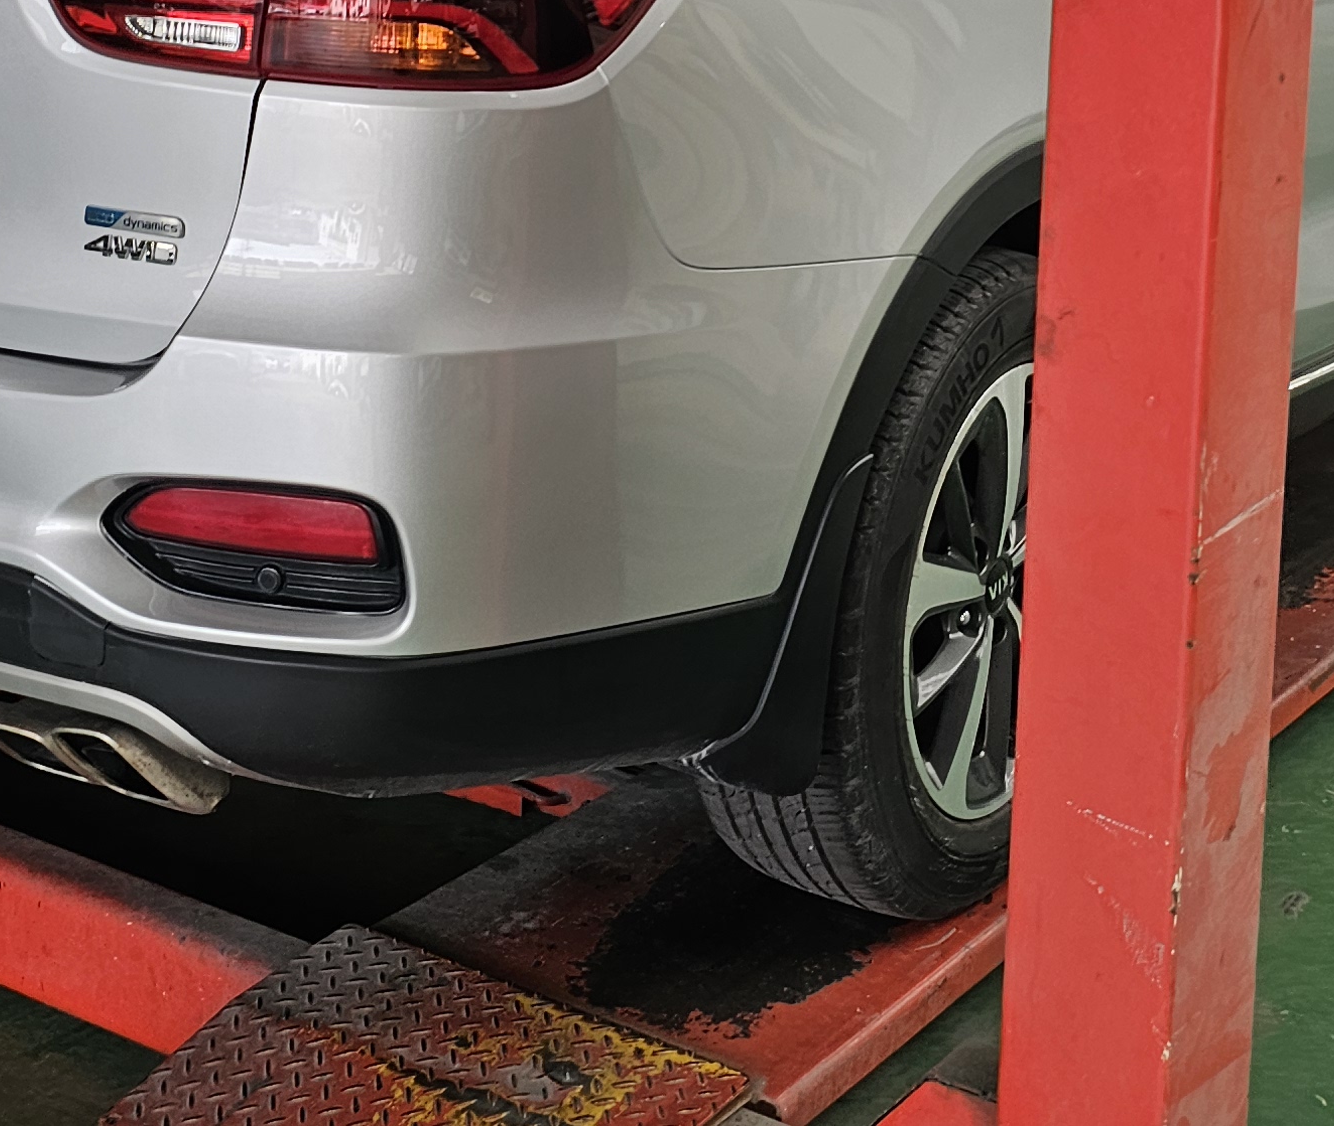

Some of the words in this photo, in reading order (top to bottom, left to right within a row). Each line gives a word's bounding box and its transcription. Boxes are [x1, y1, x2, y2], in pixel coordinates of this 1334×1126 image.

[123, 216, 178, 233] dynamics
[84, 234, 178, 265] 4WD
[915, 343, 989, 485] KUMHO
